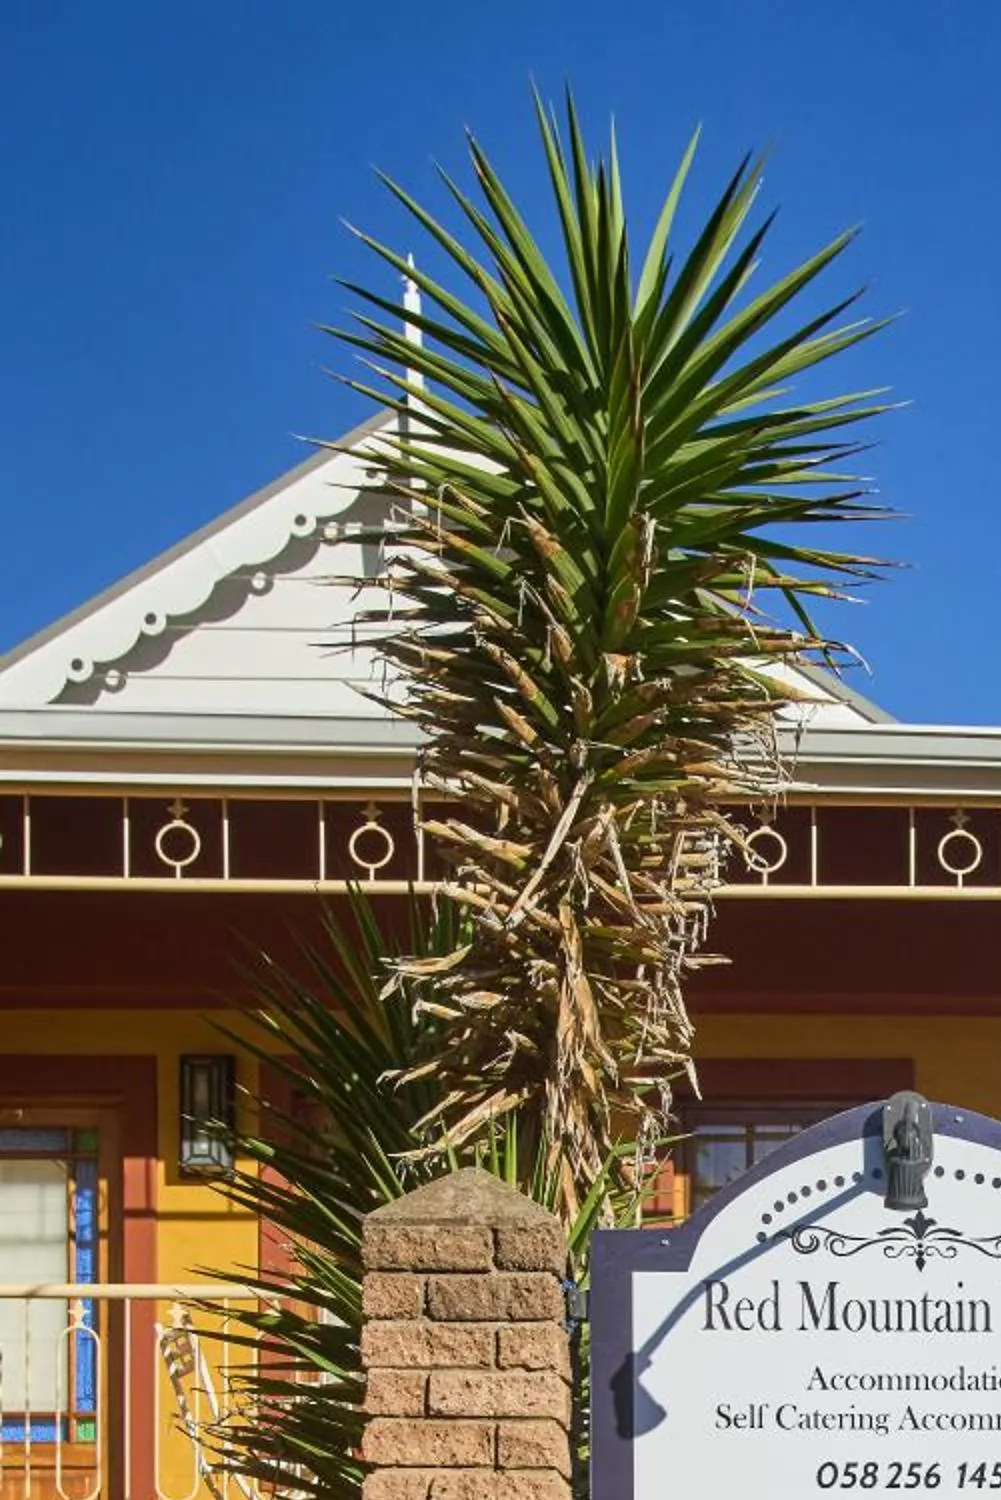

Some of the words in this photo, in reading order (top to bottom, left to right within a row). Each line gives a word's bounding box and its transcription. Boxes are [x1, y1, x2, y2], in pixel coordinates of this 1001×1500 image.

[702, 1279, 783, 1331] Red
[796, 1281, 993, 1332] Mountain
[715, 1403, 769, 1429] Self
[775, 1403, 890, 1435] Catering
[815, 1461, 879, 1489] 058
[885, 1461, 942, 1489] 256
